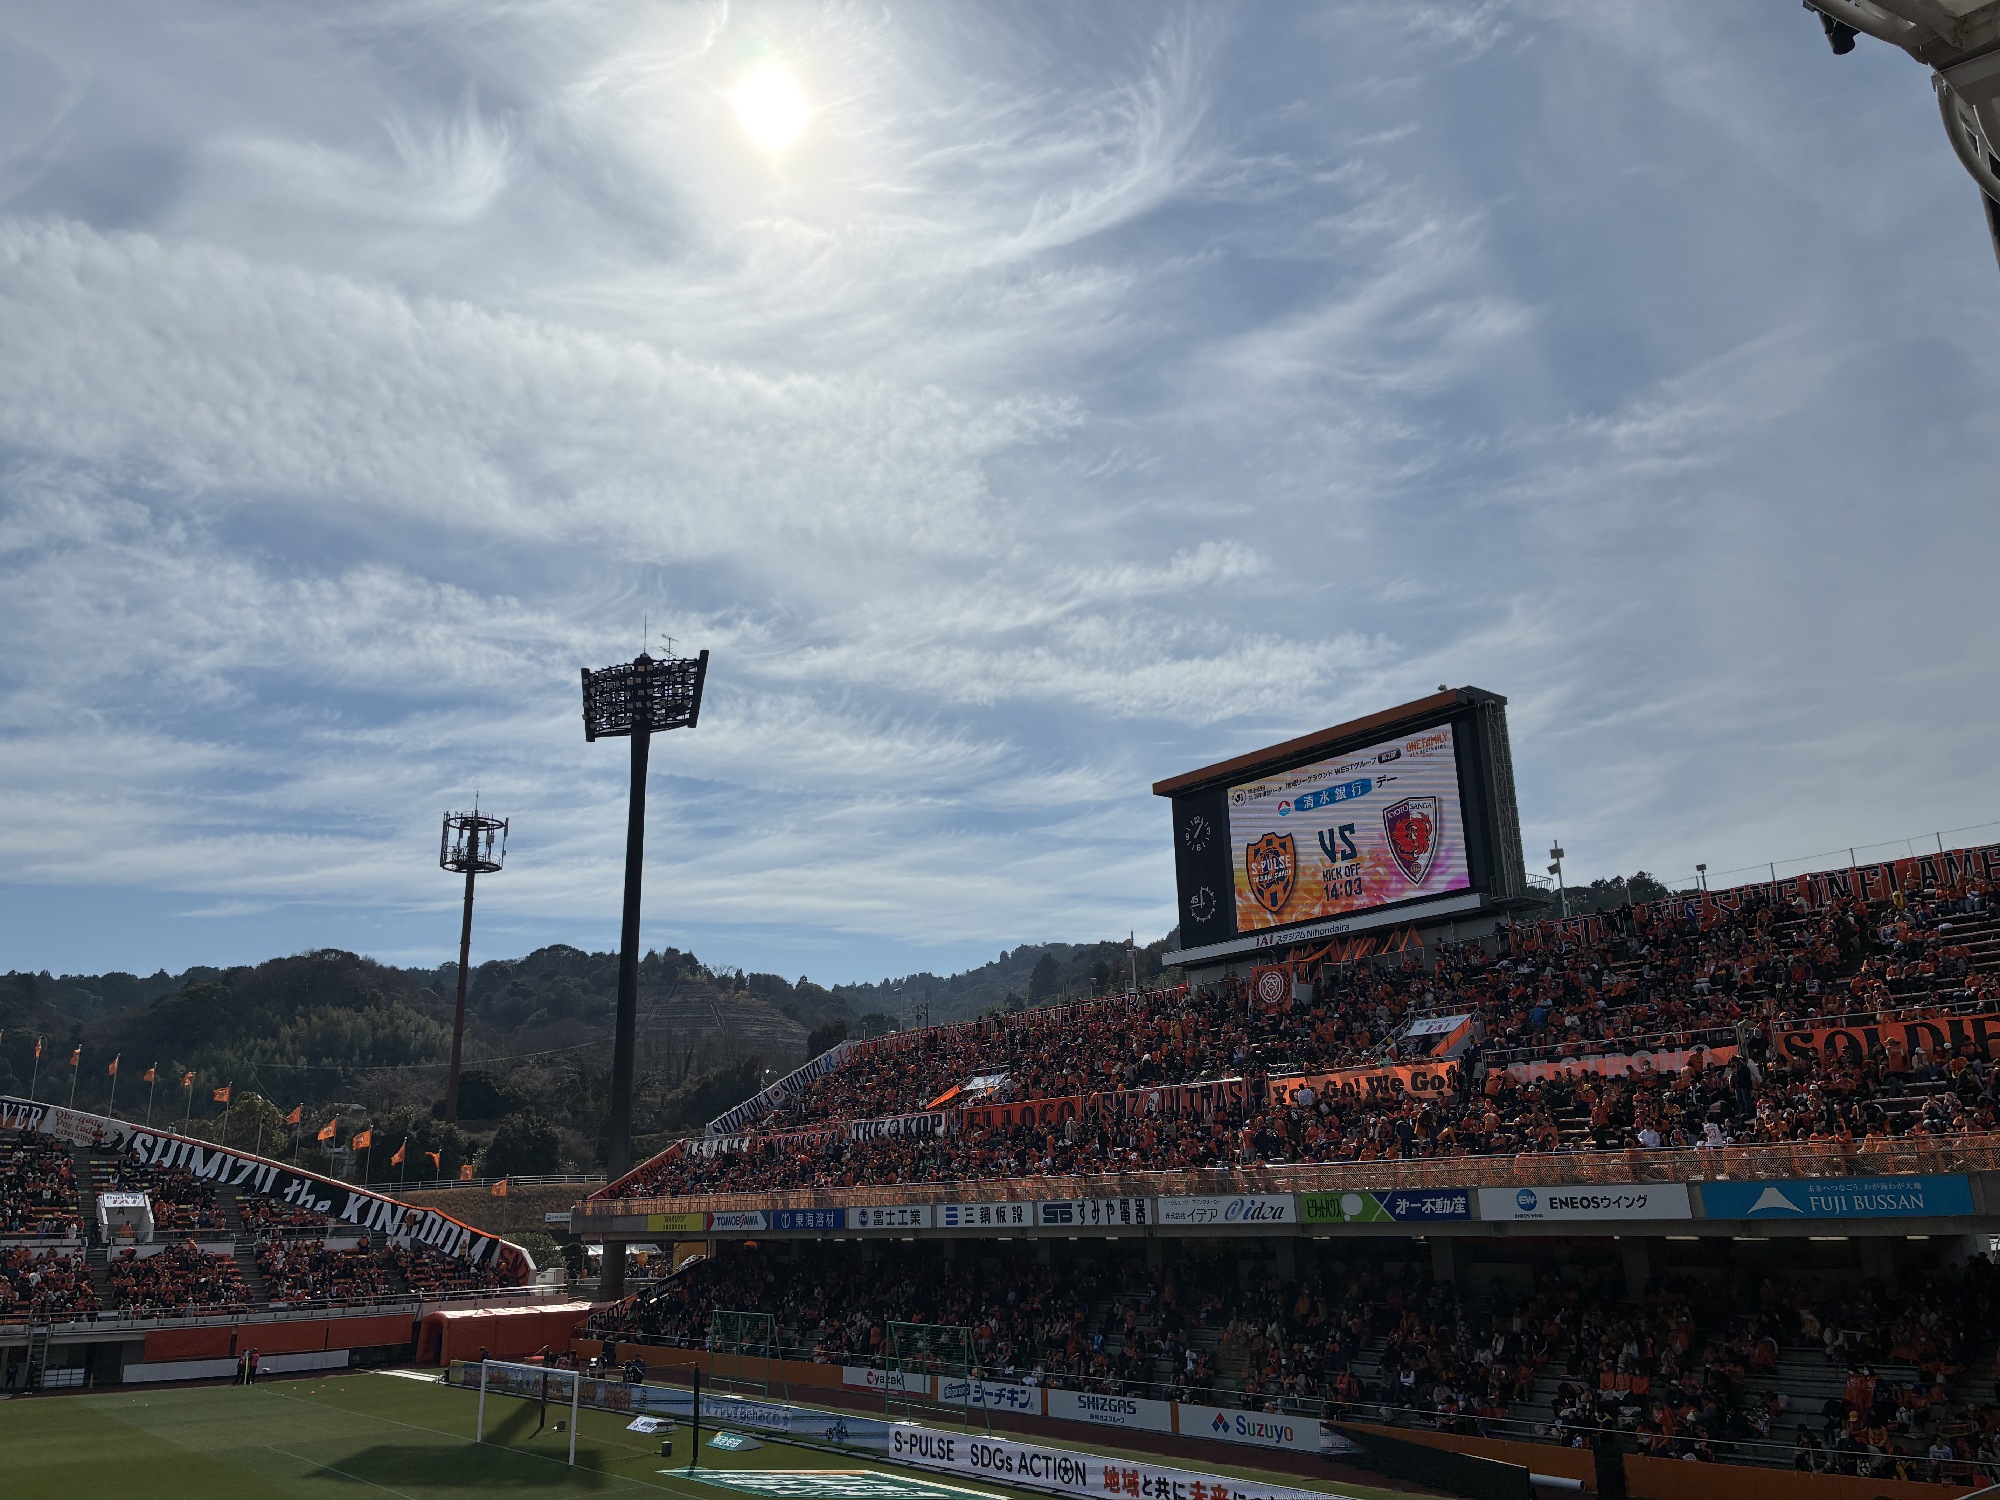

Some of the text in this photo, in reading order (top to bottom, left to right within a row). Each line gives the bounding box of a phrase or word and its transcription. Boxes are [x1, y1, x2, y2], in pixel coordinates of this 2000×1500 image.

[1406, 731, 1448, 752] ONE FAMILY
[1303, 774, 1398, 809] 清水銀行 デー
[1387, 802, 1432, 820] KYOTO SANGA
[1318, 822, 1358, 863] VS
[1251, 854, 1291, 876] S-PULSE
[1322, 862, 1361, 882] KICK OFF
[1324, 878, 1363, 902] 14:03
[1256, 934, 1274, 946] IAI
[1306, 924, 1350, 938] Nihondaira
[0, 1102, 43, 1132] VER
[116, 1207, 126, 1216] A
[1077, 1199, 1146, 1226] すみや電器
[1243, 1200, 1285, 1220] idea
[1548, 1194, 1648, 1210] ENEOSウイング
[1809, 1194, 1924, 1214] FUJI BUSSAN
[873, 1208, 922, 1226] 富士工業
[972, 1385, 1030, 1408] シーチキン
[1078, 1394, 1137, 1415] SHIZGAS
[1235, 1414, 1294, 1444] Suzuyo
[894, 1430, 955, 1462] S-PULSE
[970, 1444, 1013, 1472] SDGs
